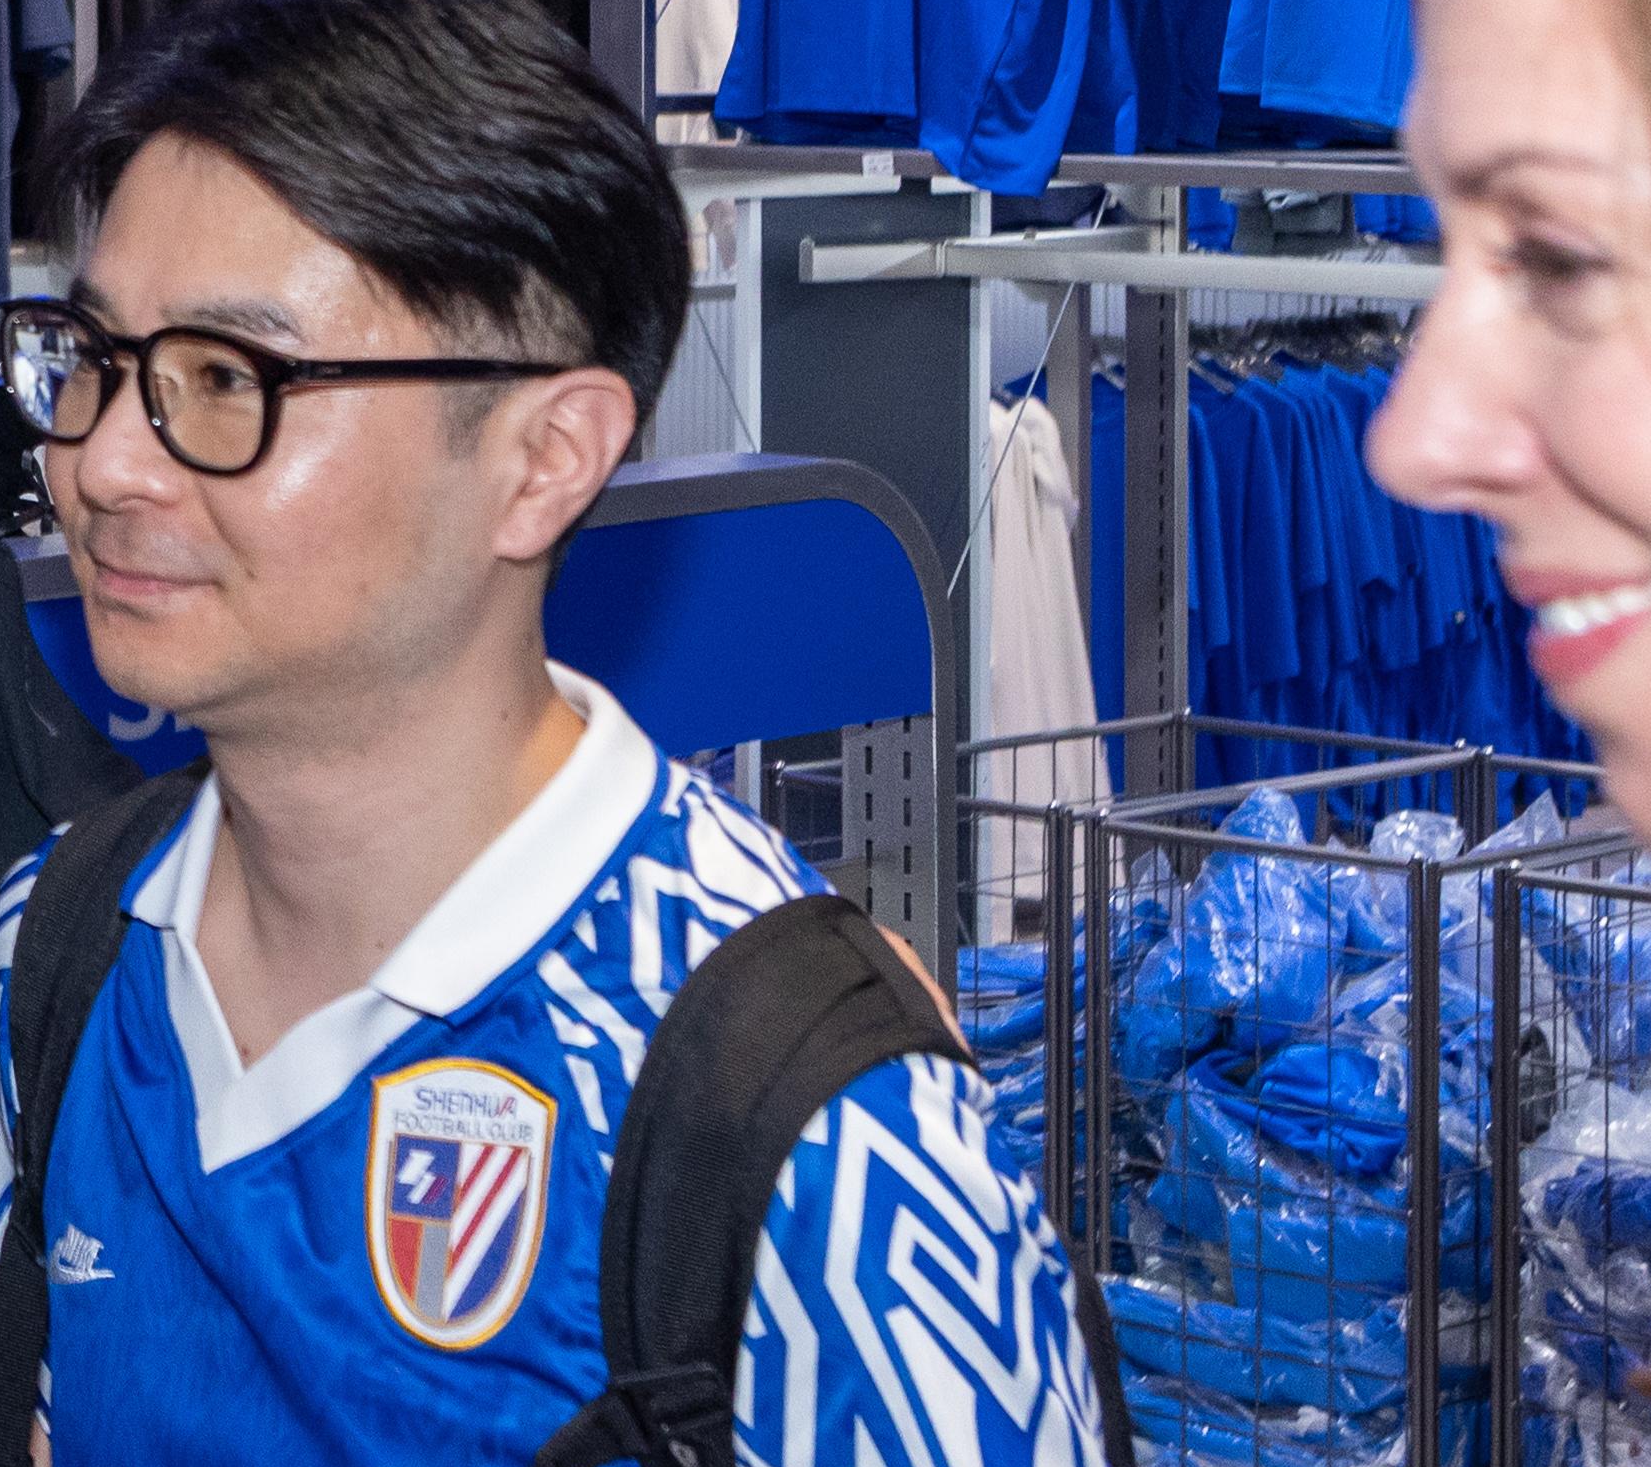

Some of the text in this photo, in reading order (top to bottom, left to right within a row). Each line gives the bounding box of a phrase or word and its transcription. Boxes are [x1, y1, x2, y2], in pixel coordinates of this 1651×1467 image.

[414, 1086, 518, 1120] SHENHUA
[394, 1108, 535, 1143] FOOTBALL CLUB
